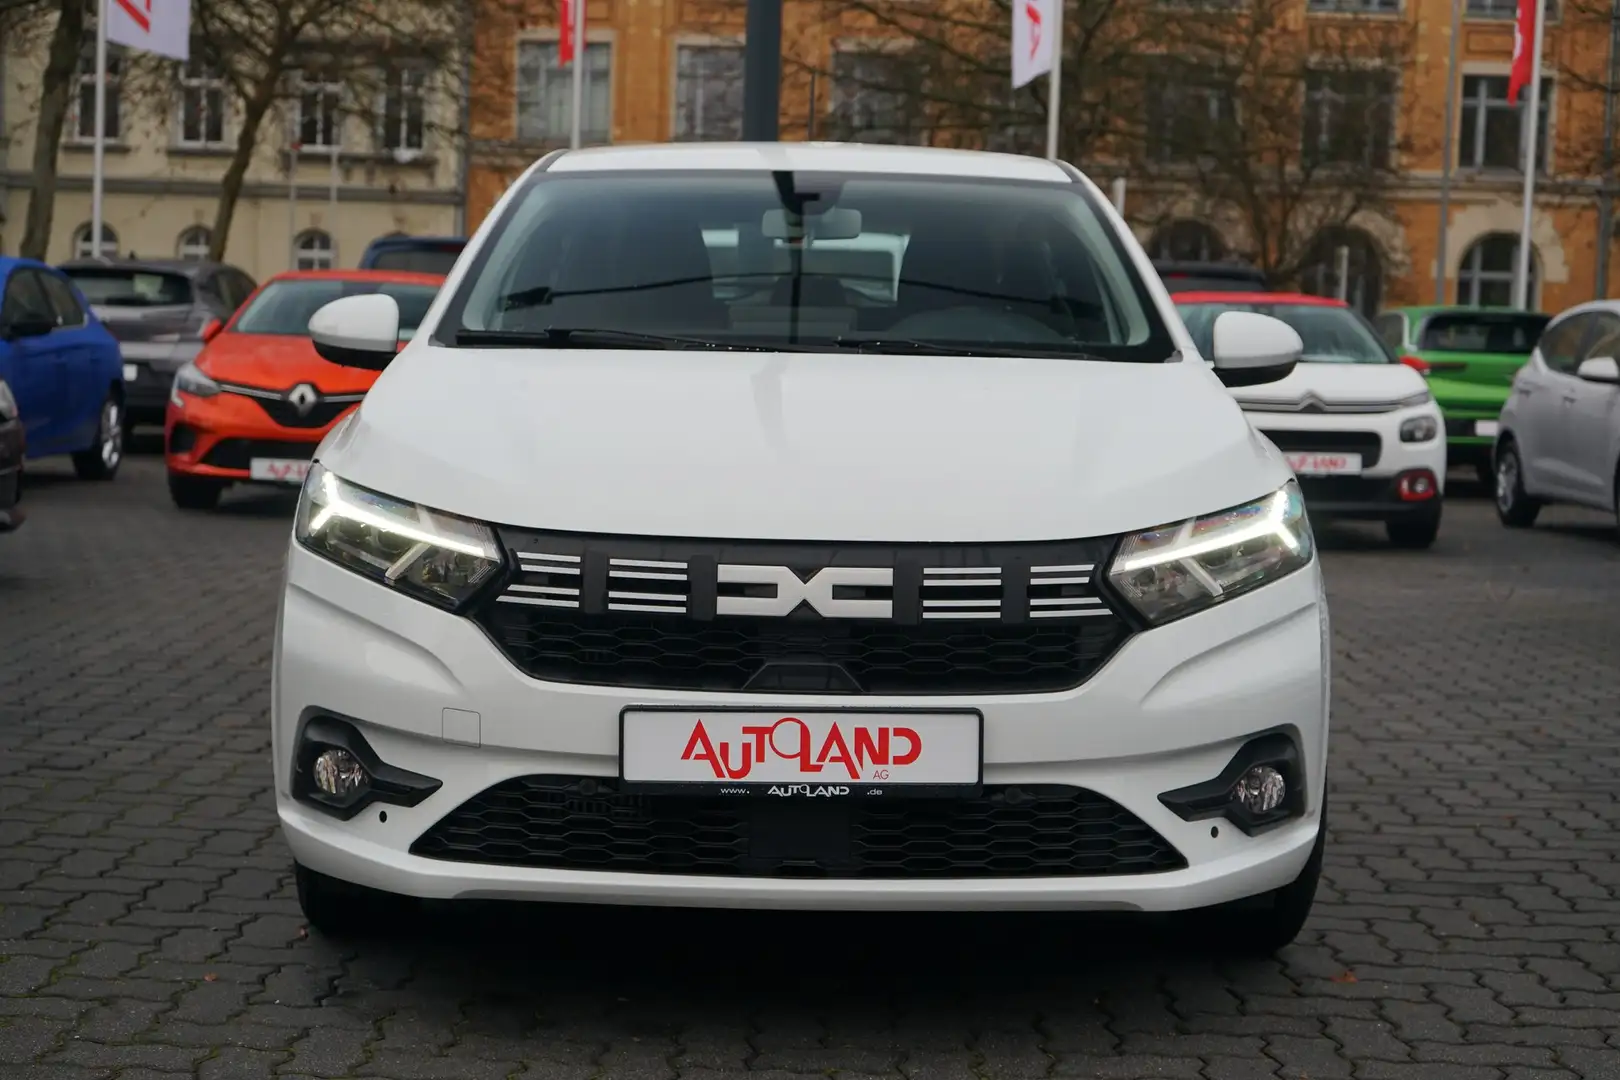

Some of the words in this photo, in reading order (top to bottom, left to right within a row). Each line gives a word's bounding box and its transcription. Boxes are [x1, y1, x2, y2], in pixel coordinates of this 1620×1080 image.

[681, 717, 922, 780] AUTOLAND
[873, 768, 890, 780] AG
[720, 788, 750, 796] www.
[767, 784, 850, 798] AUTOLAND
[866, 787, 884, 796] .de
